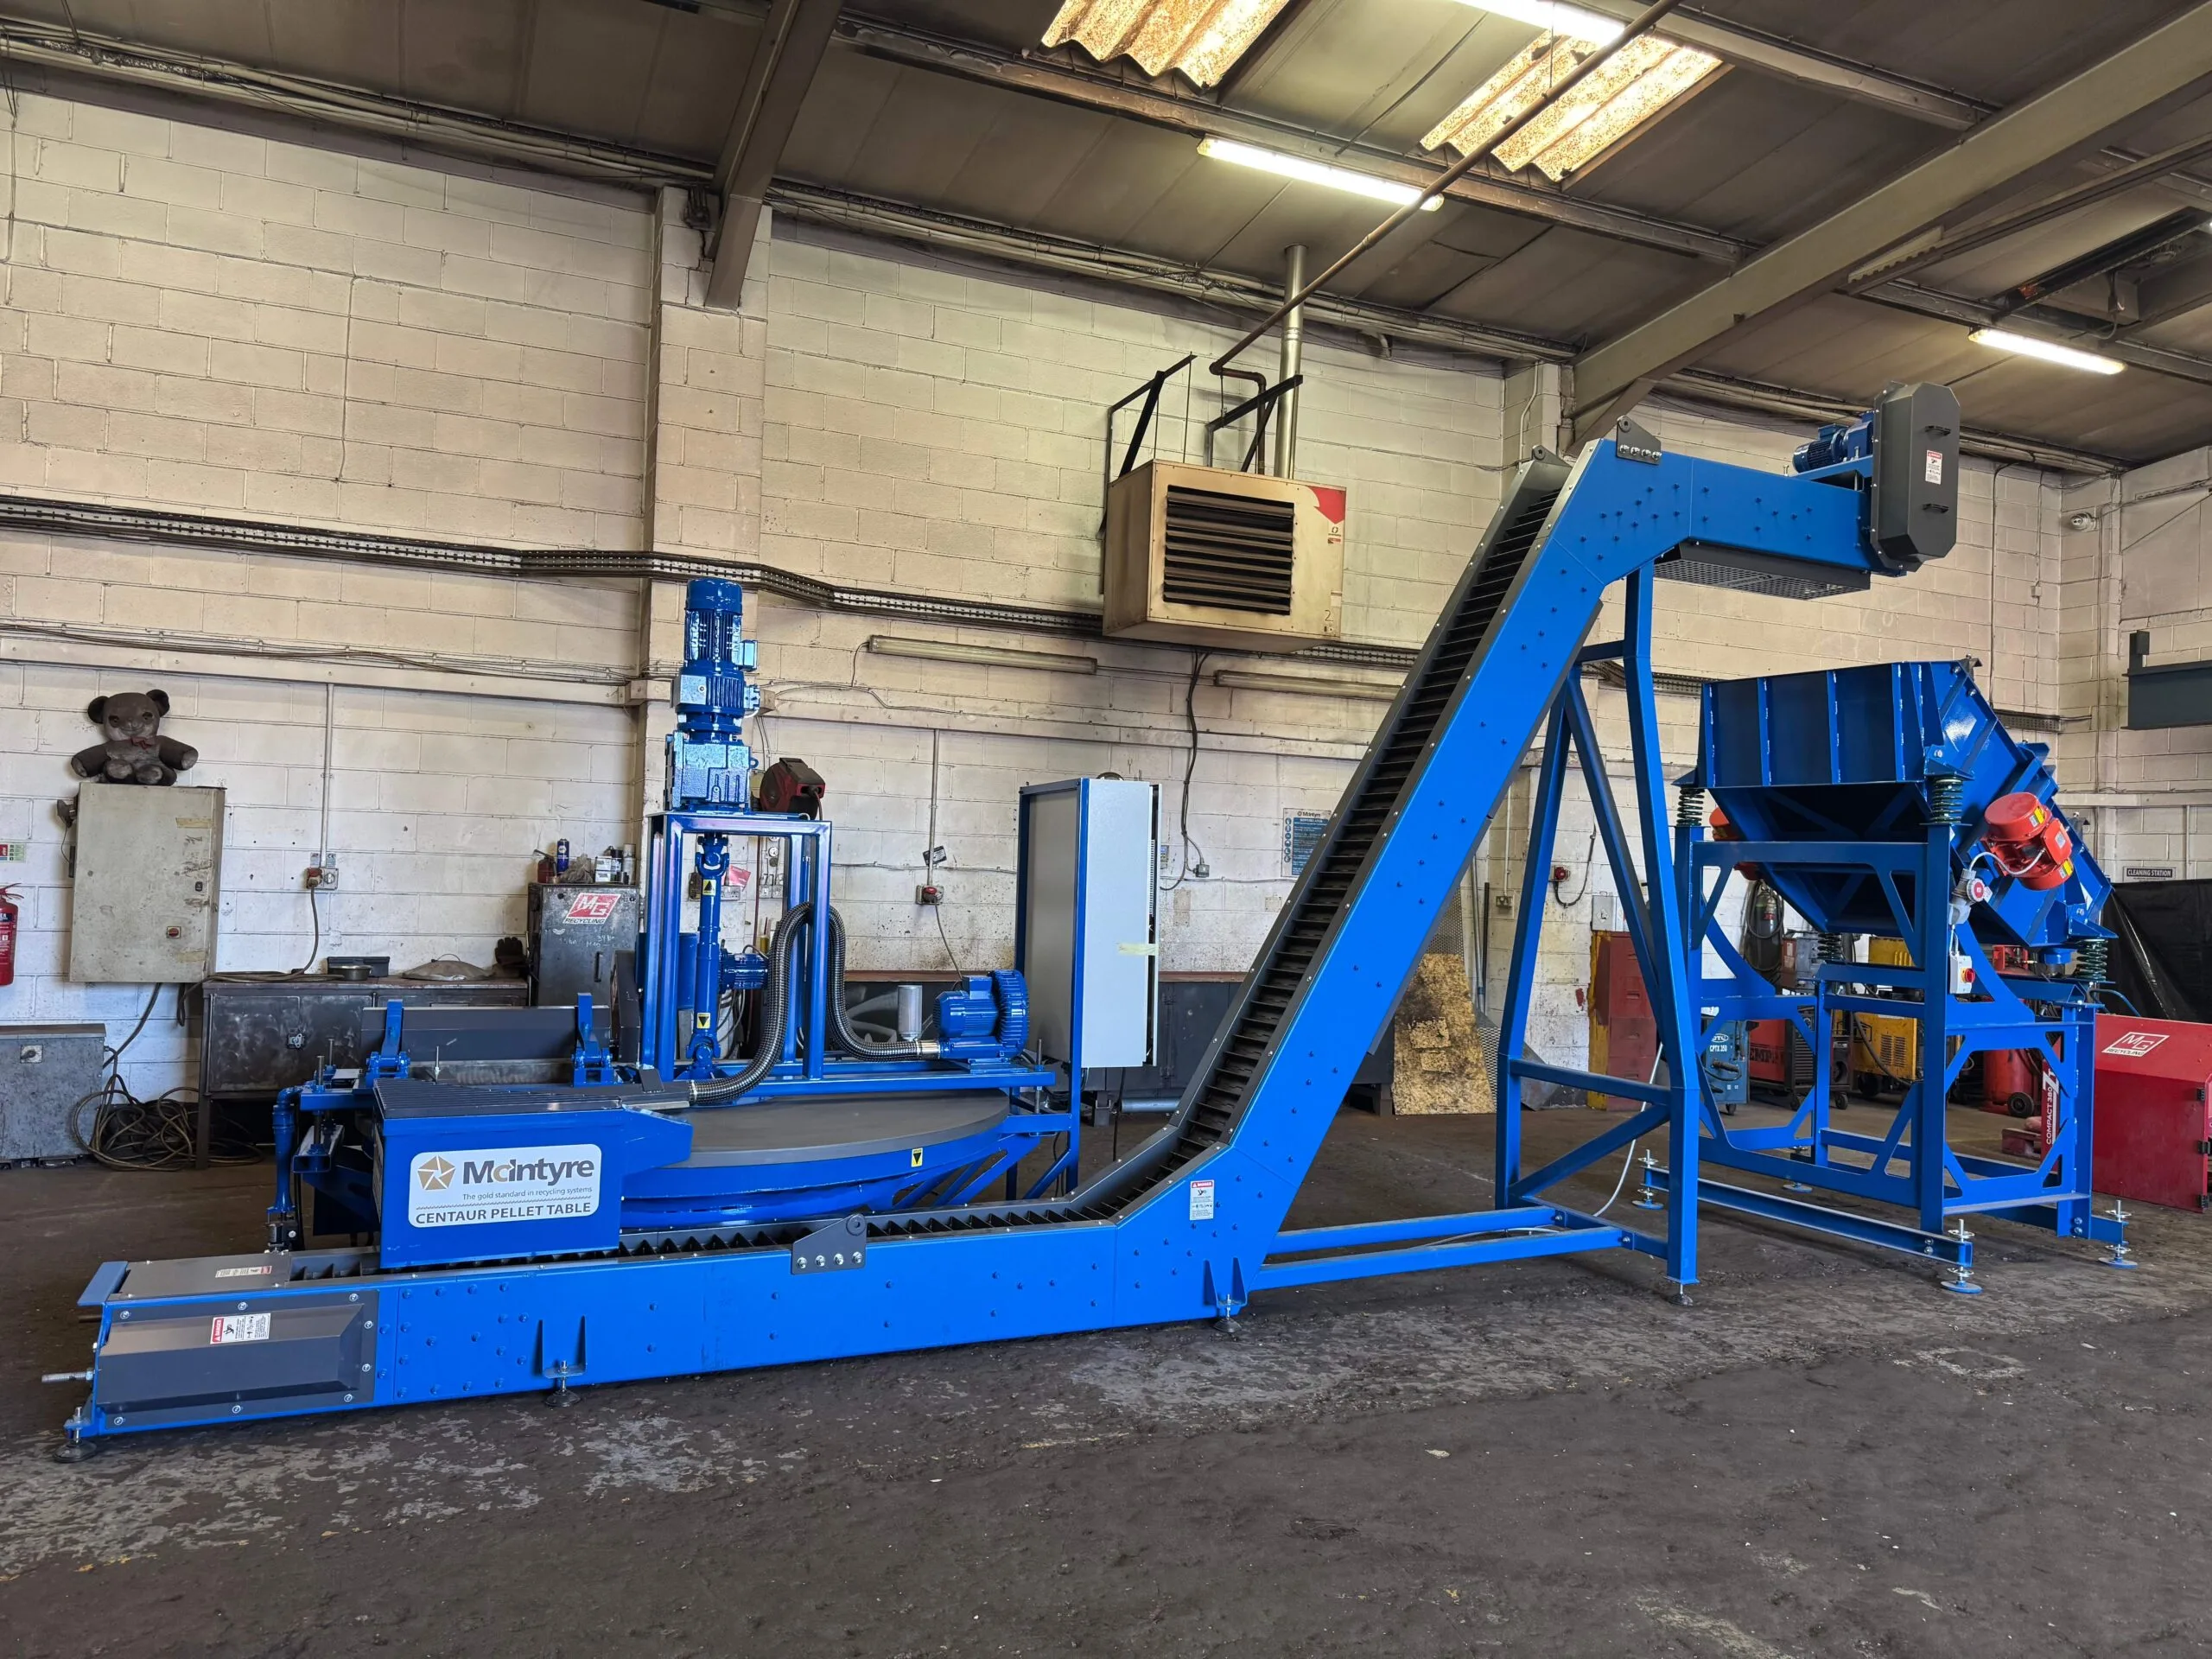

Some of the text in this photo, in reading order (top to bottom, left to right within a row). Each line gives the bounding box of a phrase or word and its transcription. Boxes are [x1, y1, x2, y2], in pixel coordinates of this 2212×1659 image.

[2121, 1034, 2155, 1050] MG
[478, 1192, 493, 1201] gold
[495, 1190, 526, 1198] standard
[536, 1188, 566, 1197] recycling
[416, 1202, 591, 1224] CENTAUR PELLET TABLE
